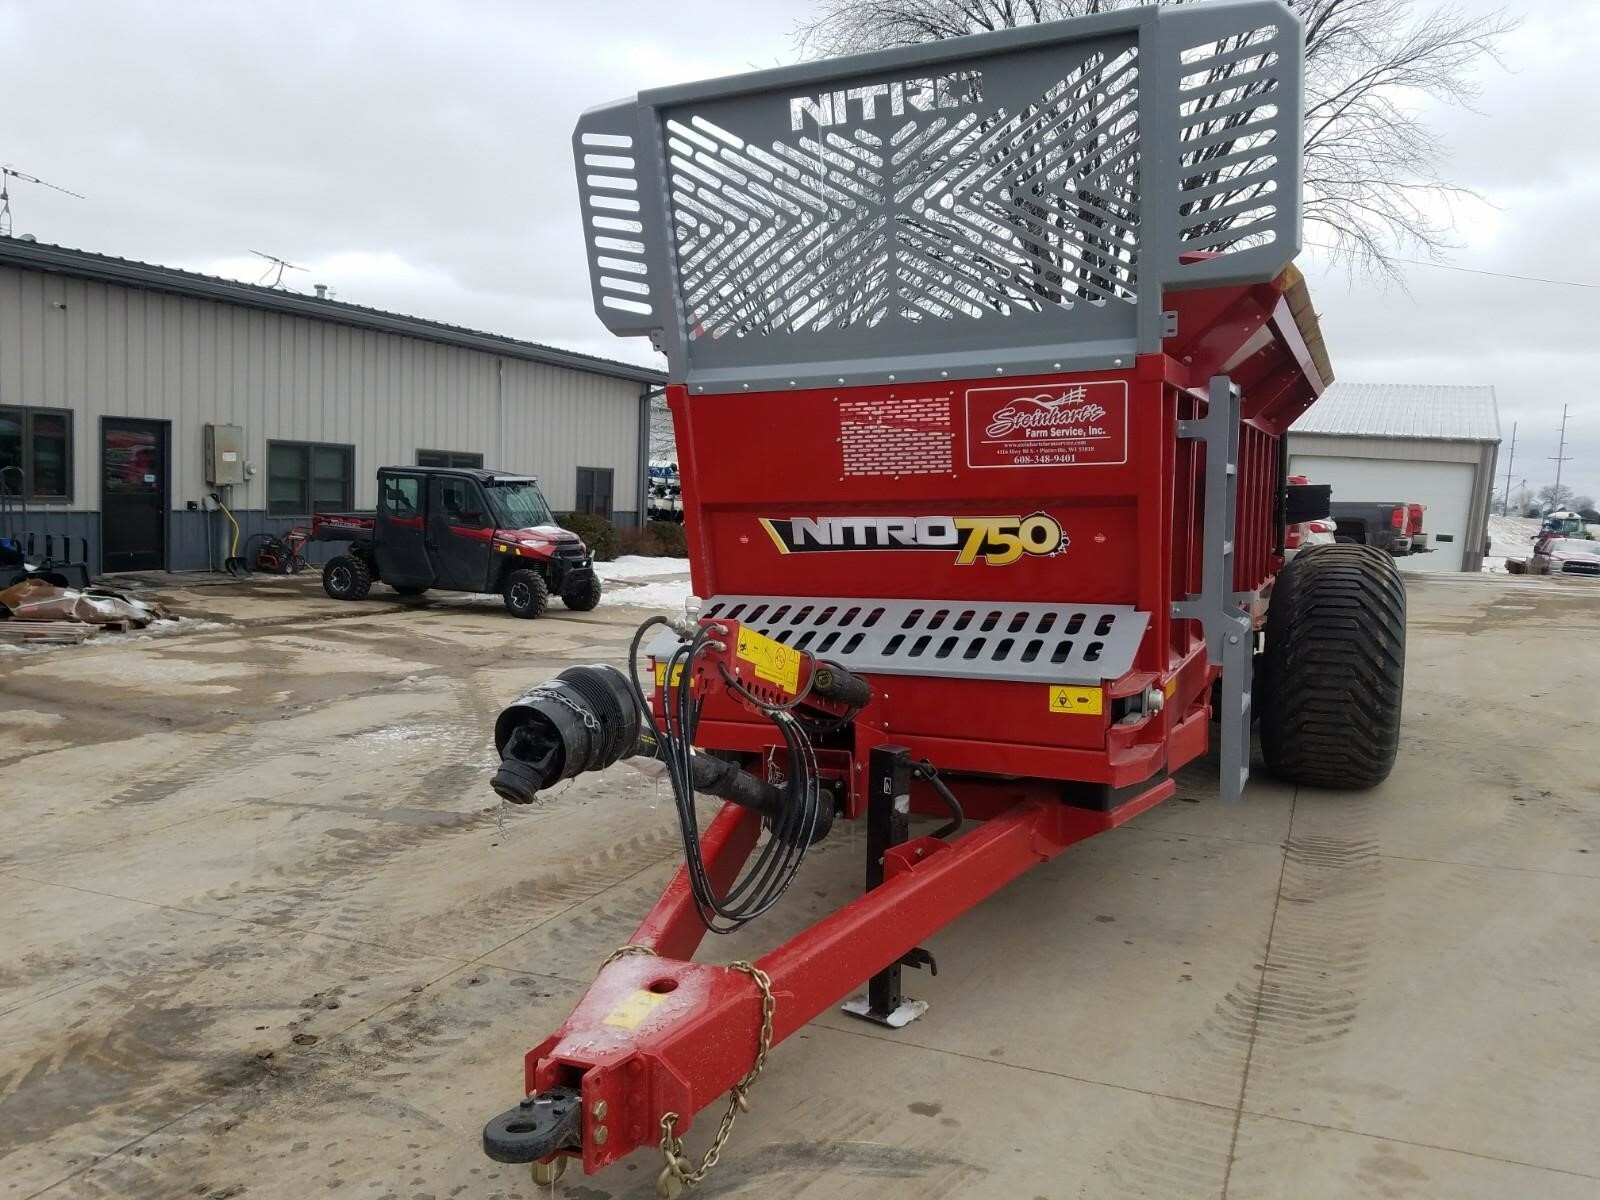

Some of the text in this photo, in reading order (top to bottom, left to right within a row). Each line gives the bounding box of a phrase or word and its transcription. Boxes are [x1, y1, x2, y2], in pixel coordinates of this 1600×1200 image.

[789, 70, 984, 131] NITRO
[986, 403, 1106, 437] Steinhart's
[1025, 425, 1106, 438] Farm Service, Inc.
[1014, 454, 1076, 464] 608-348-9401
[791, 512, 1062, 566] NITRO 750
